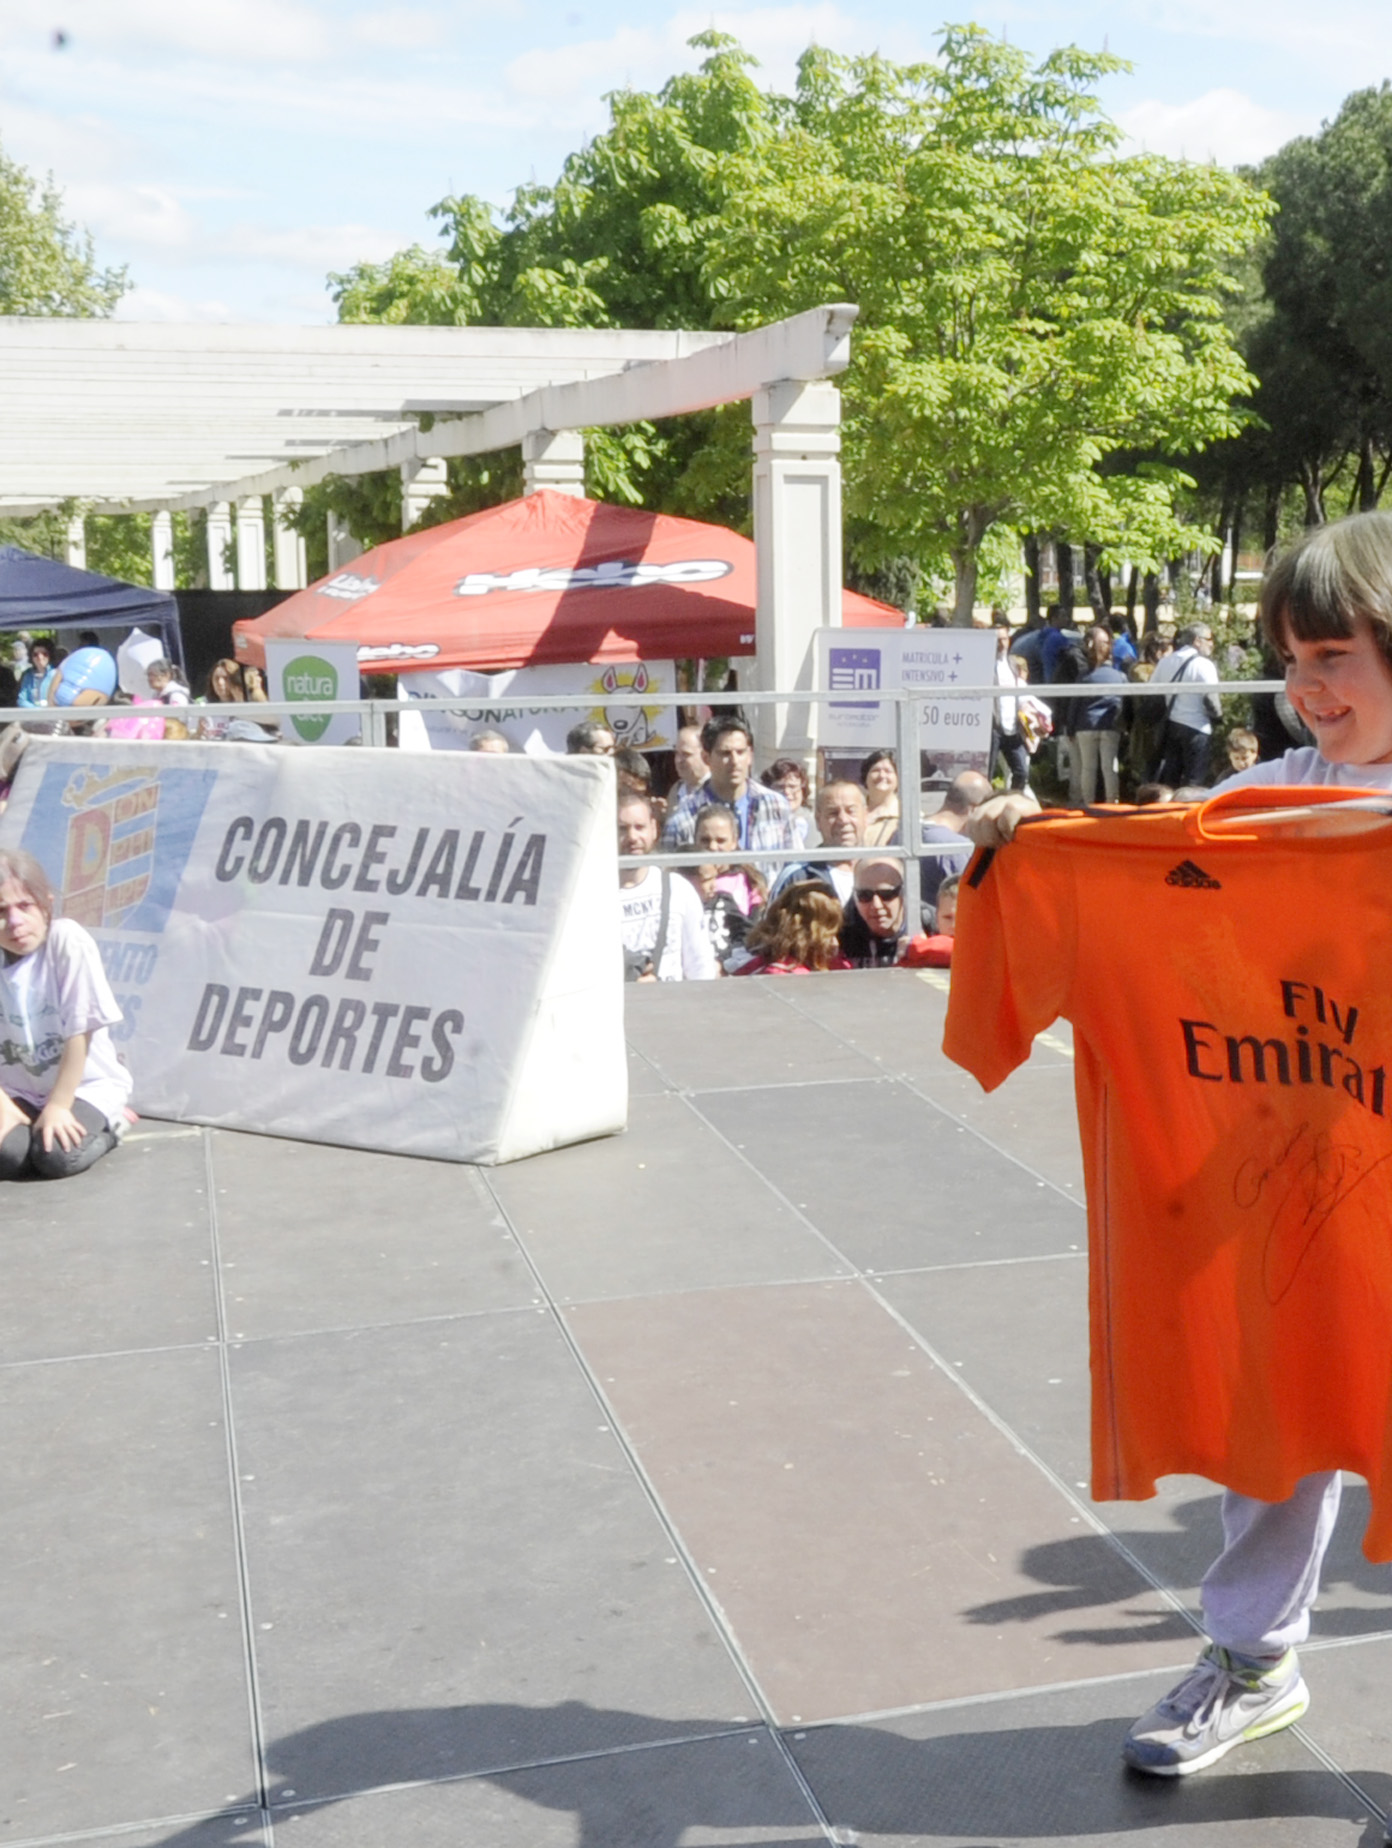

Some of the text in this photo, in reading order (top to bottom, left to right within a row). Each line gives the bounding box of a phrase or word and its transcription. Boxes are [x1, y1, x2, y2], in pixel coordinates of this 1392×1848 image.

[902, 652, 949, 665] MATRICULA
[902, 669, 945, 682] INTENSIVO
[286, 672, 334, 696] natura
[944, 713, 981, 726] euros
[215, 816, 547, 906] CONCEJALÍA
[309, 907, 390, 982] DE
[186, 983, 465, 1083] DEPORTES
[1279, 979, 1358, 1045] Fly
